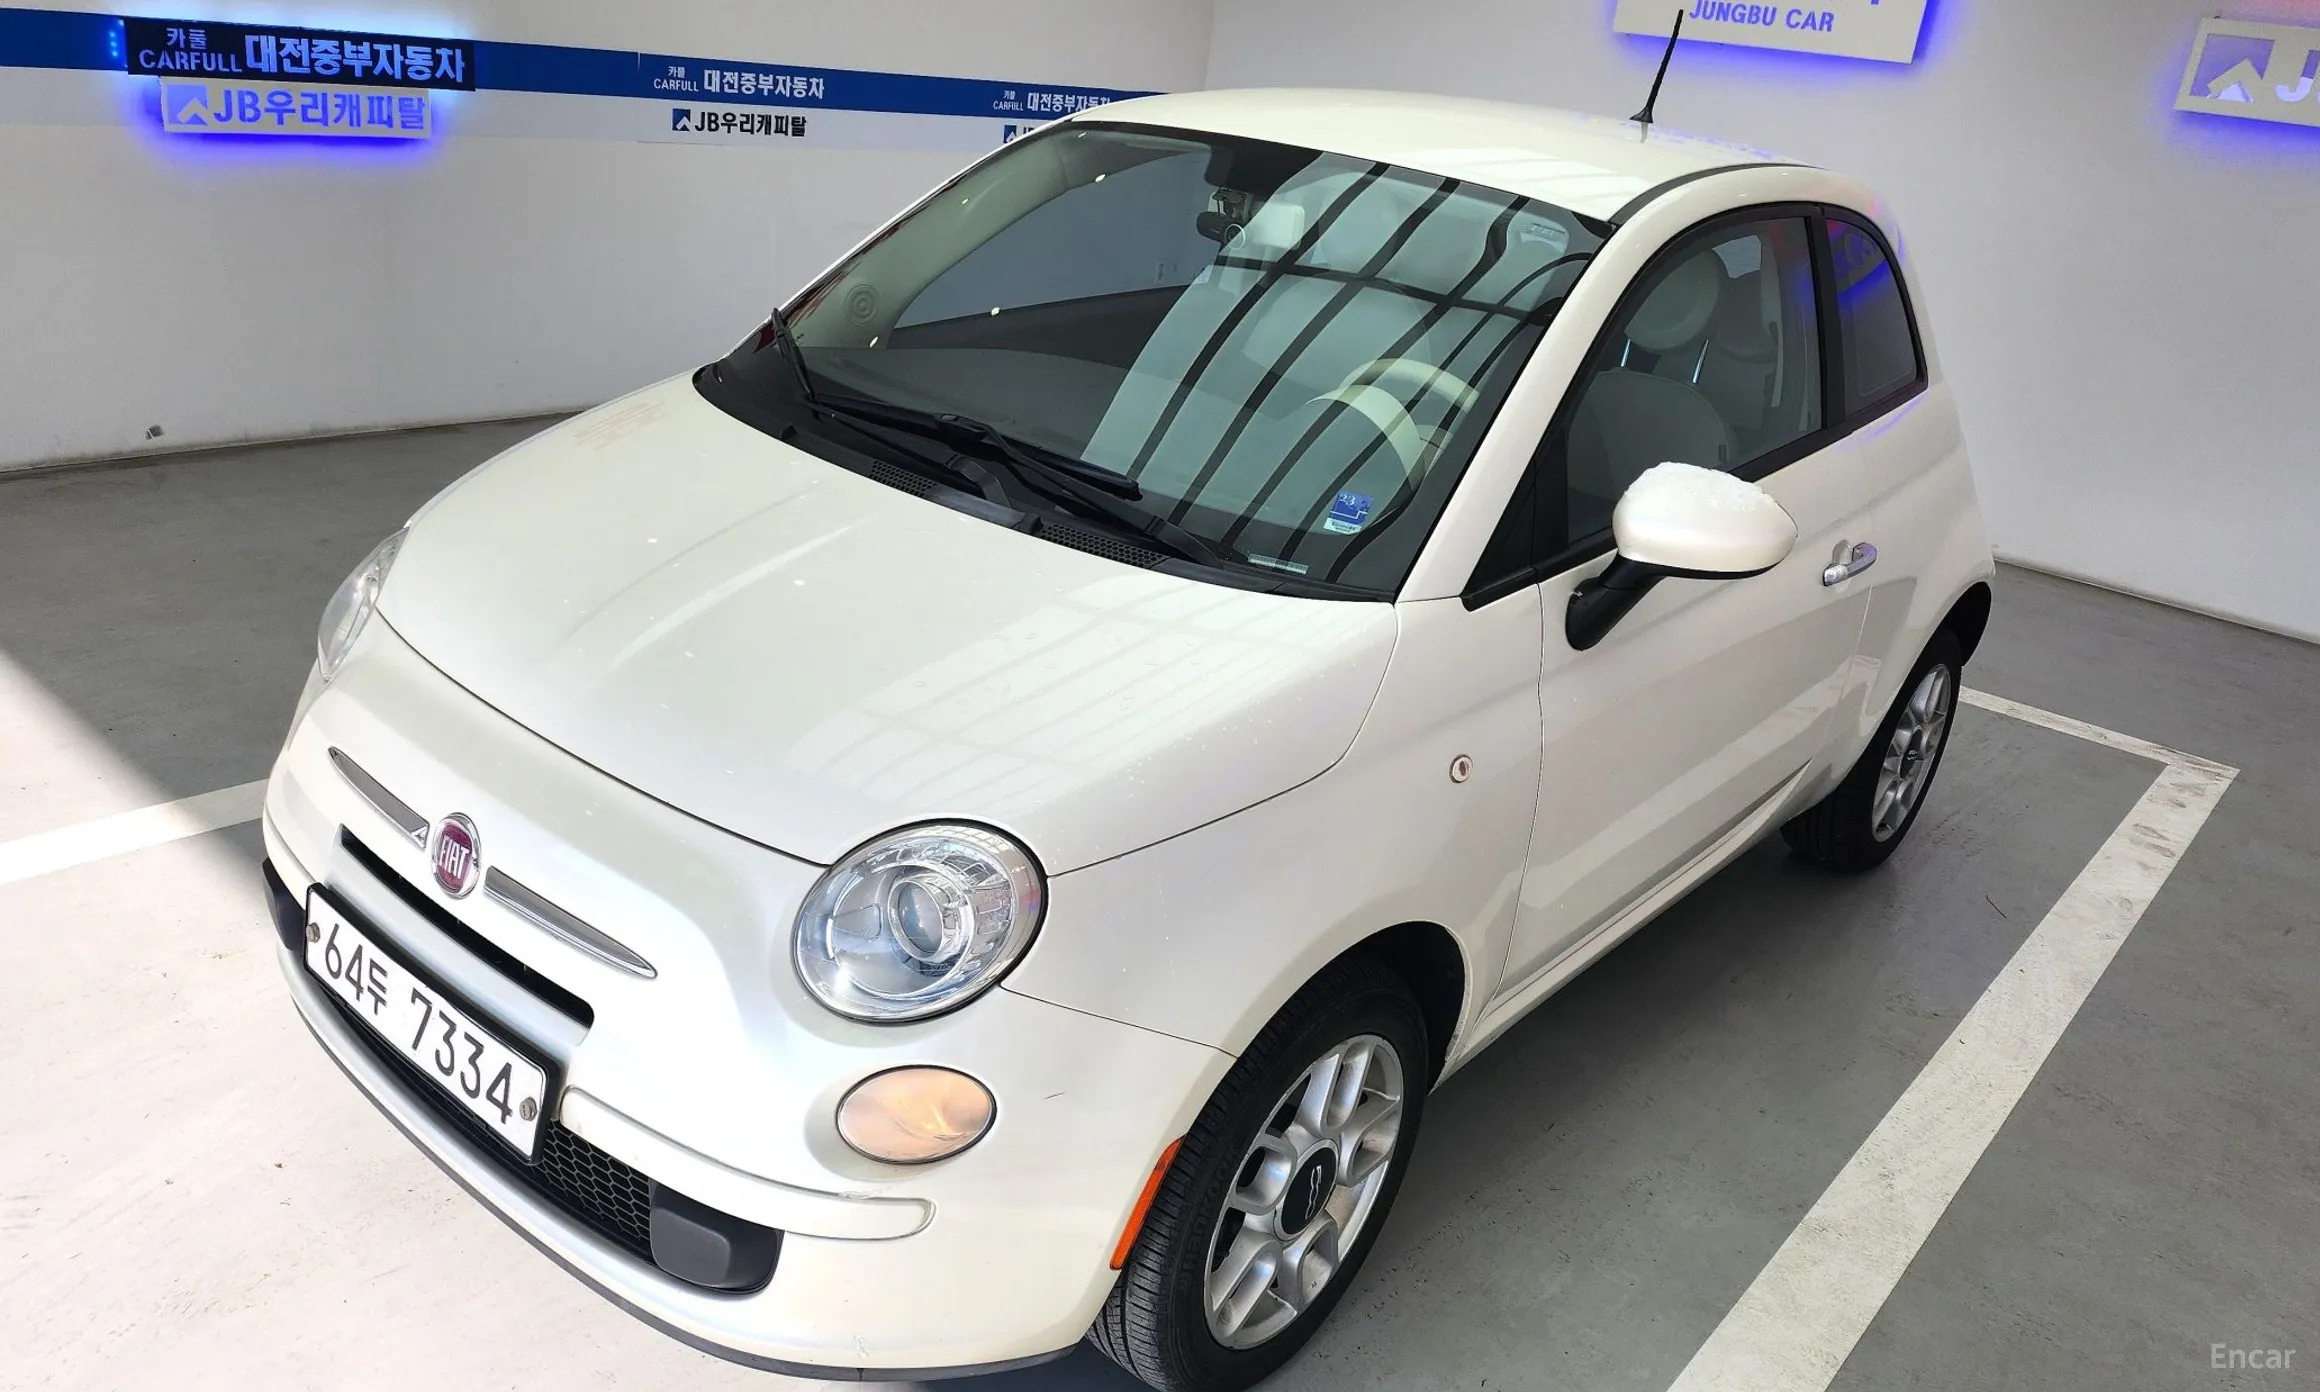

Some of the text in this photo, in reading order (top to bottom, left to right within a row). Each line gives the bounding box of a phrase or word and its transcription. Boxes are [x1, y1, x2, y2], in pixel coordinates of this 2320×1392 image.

[1689, 0, 1835, 32] JUNGBU CAR
[138, 49, 243, 73] CARFULL
[244, 34, 465, 84] 대전중부자동차
[653, 77, 699, 93] CARFULL
[703, 69, 825, 100] 대전중부자동차
[2275, 49, 2320, 102] J
[213, 88, 426, 130] JB우리캐피탈
[992, 100, 1024, 112] CARFULL
[694, 110, 807, 138] JB우리캐피탈
[439, 837, 470, 879] FIAT
[324, 923, 513, 1125] 64두 7334
